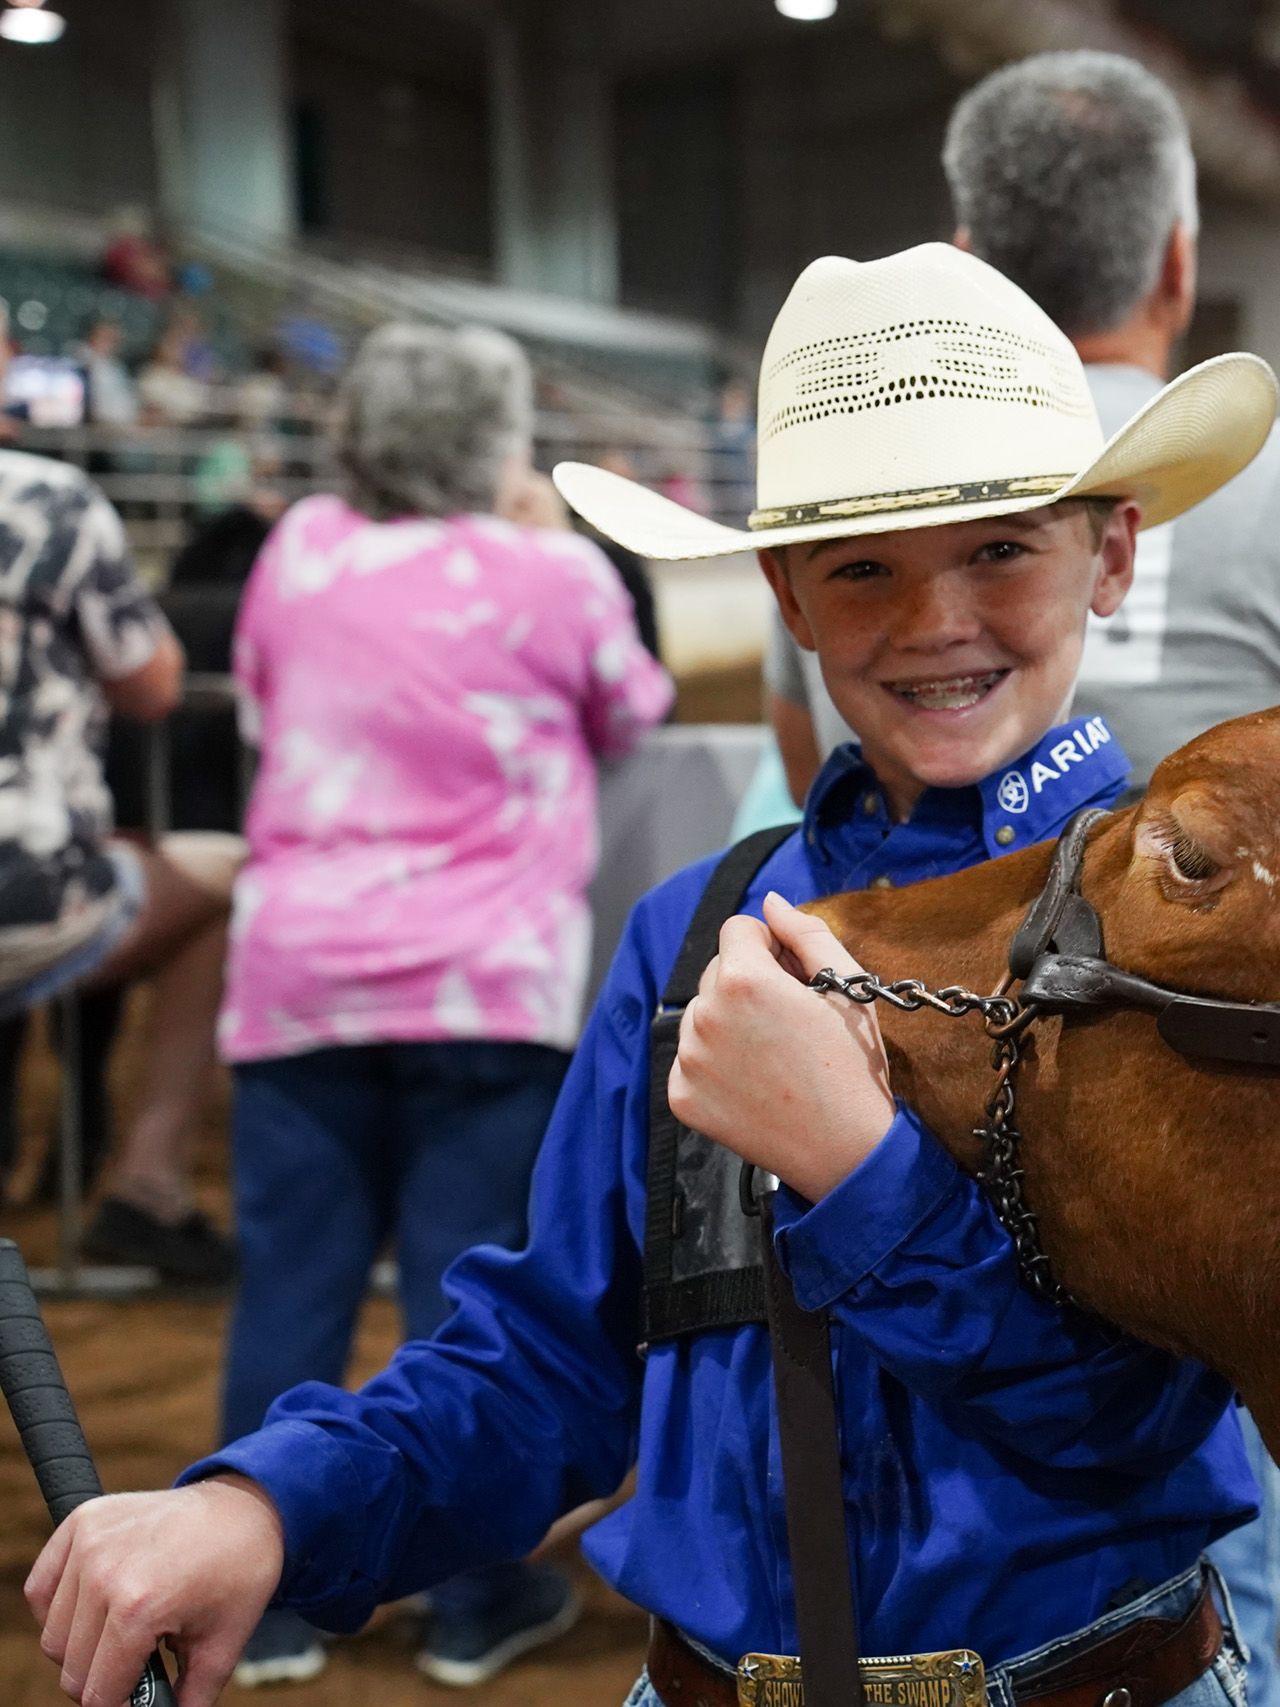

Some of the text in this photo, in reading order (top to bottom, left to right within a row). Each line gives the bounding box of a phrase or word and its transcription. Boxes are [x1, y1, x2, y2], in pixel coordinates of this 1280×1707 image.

[1031, 717, 1111, 793] ARIAT
[765, 1679, 950, 1707] SHOW THE SWAMP
